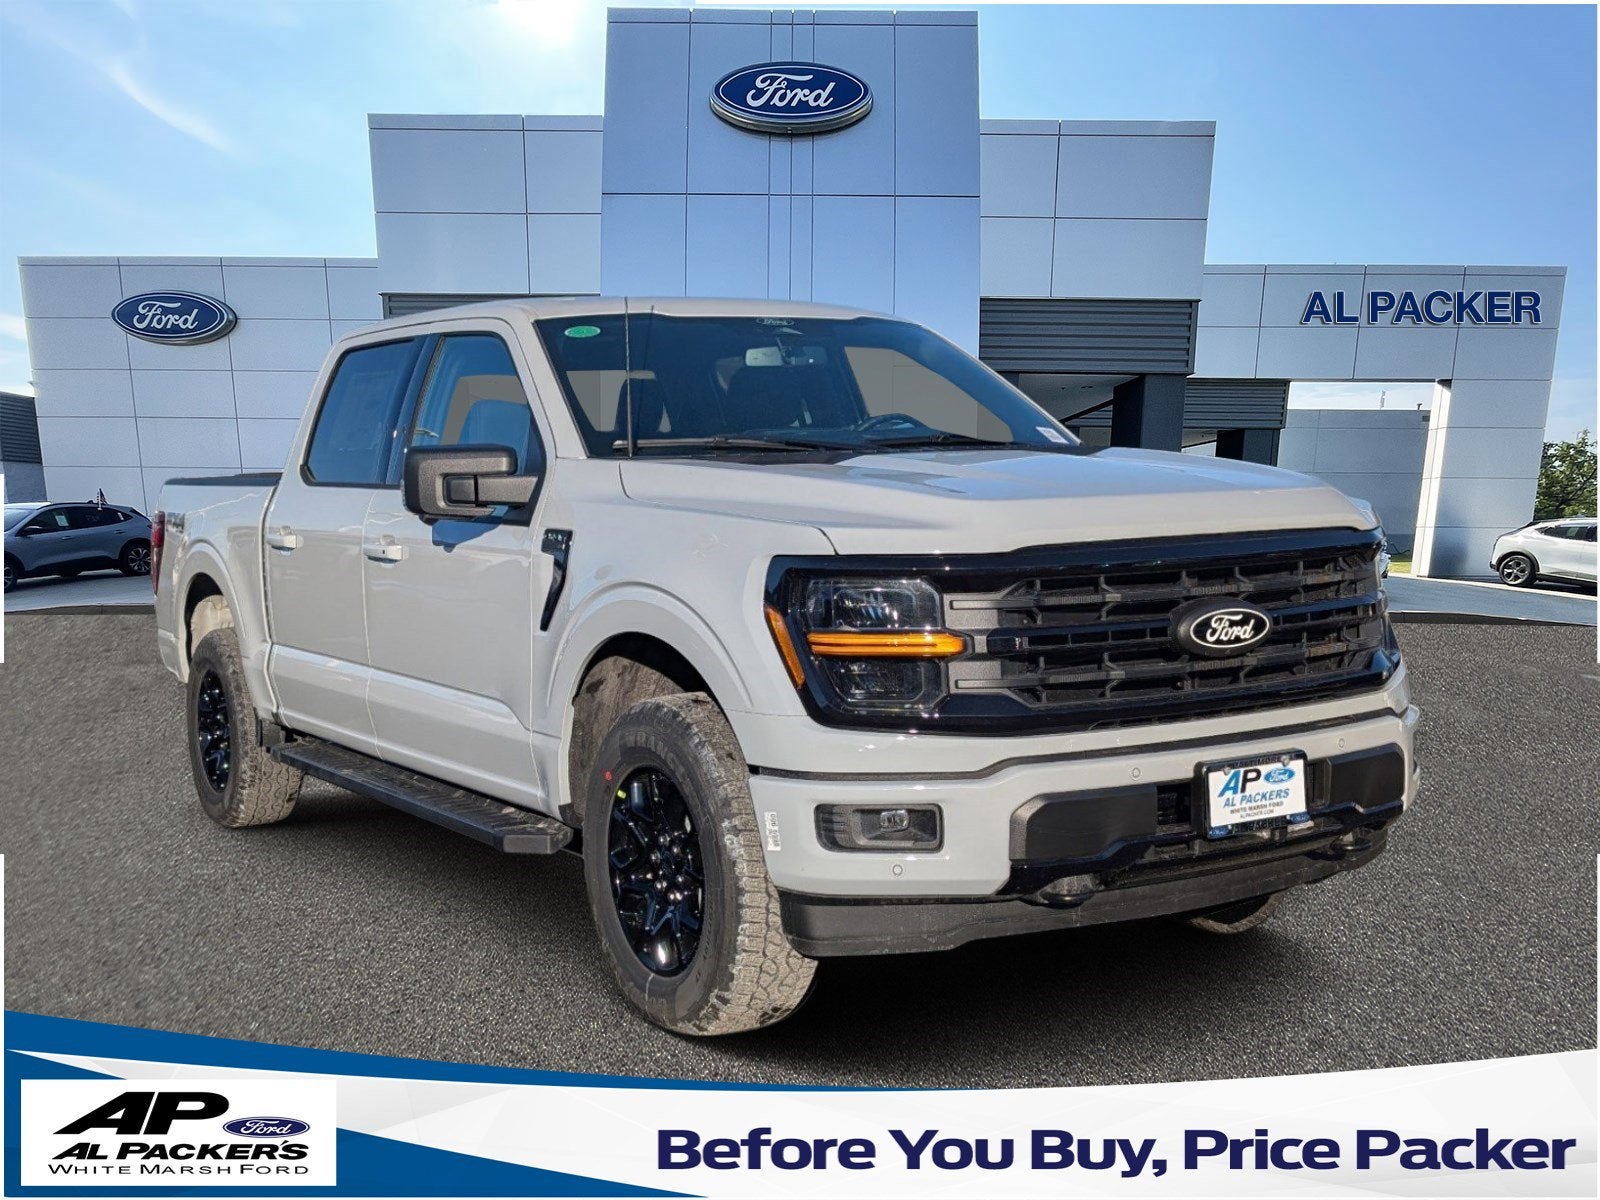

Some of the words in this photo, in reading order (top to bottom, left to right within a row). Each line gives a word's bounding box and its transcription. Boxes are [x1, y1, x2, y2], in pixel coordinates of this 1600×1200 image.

[746, 73, 836, 108] Ford
[133, 301, 199, 329] Ford
[1301, 291, 1360, 324] AL
[1368, 290, 1542, 325] PACKER
[1206, 614, 1255, 642] Ford
[1218, 768, 1262, 797] AP
[1223, 796, 1236, 808] AL
[1240, 788, 1290, 806] PACKERS
